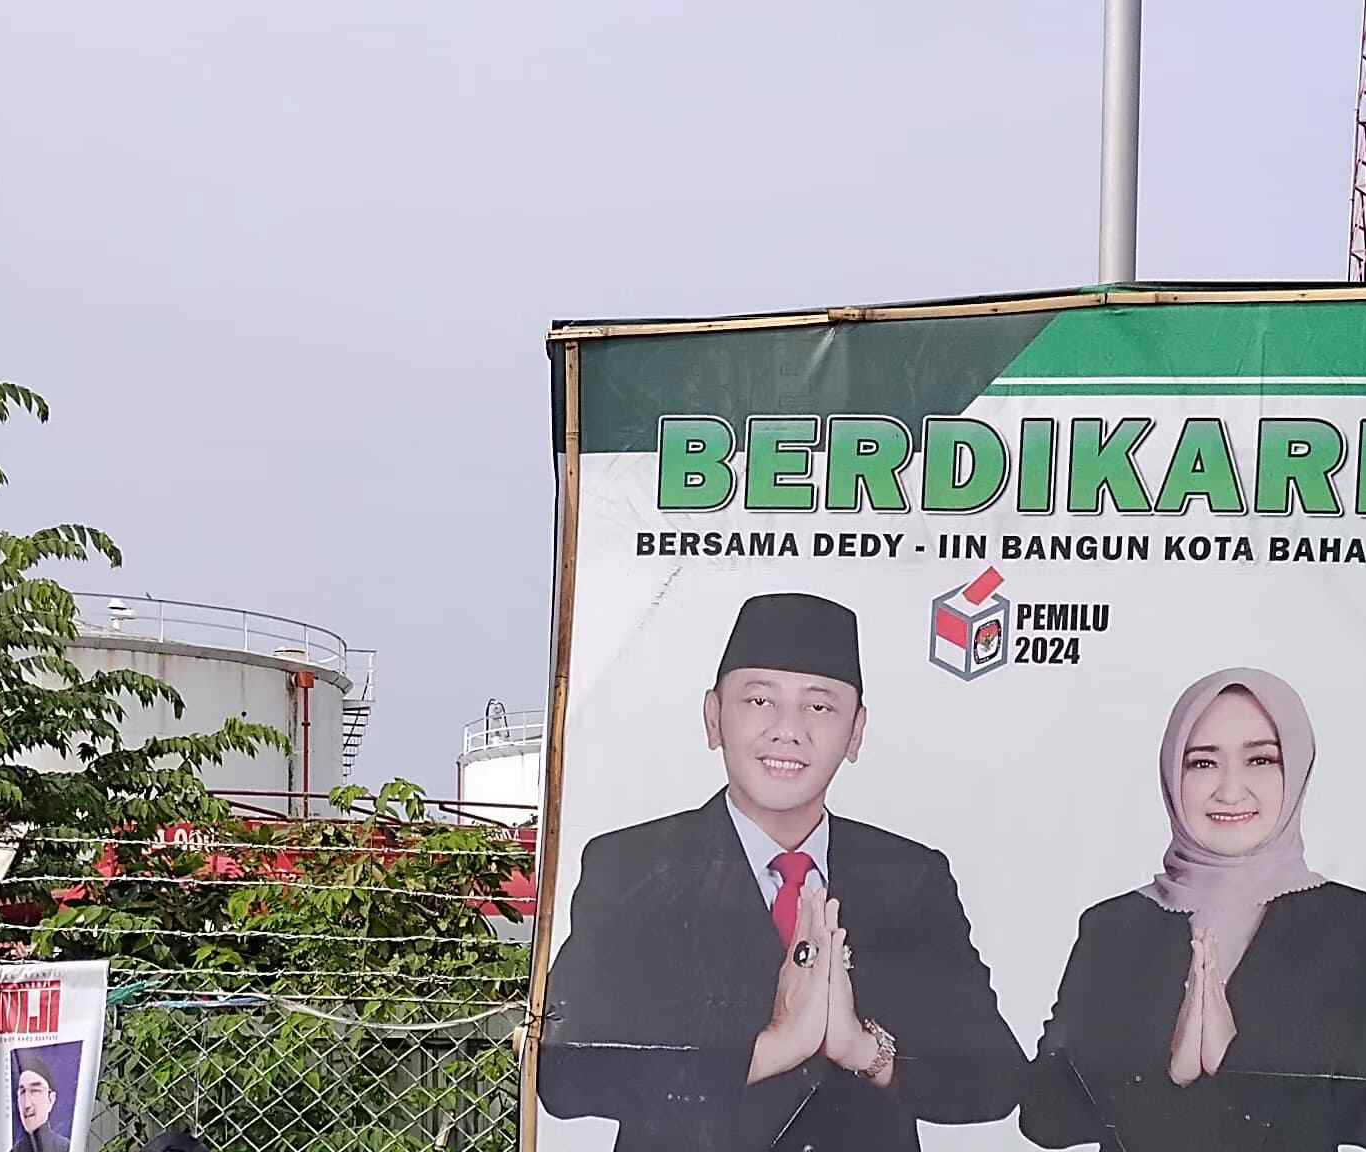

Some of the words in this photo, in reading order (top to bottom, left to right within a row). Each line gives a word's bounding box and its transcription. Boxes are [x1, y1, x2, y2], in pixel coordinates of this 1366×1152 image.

[636, 529, 799, 559] BERSAMA
[813, 531, 903, 560] DEDY
[937, 532, 989, 561] IIN
[1001, 534, 1149, 562] BANGUN
[1164, 535, 1252, 563] KOTA
[1016, 603, 1110, 632] PEMILU
[1015, 637, 1081, 665] 2024
